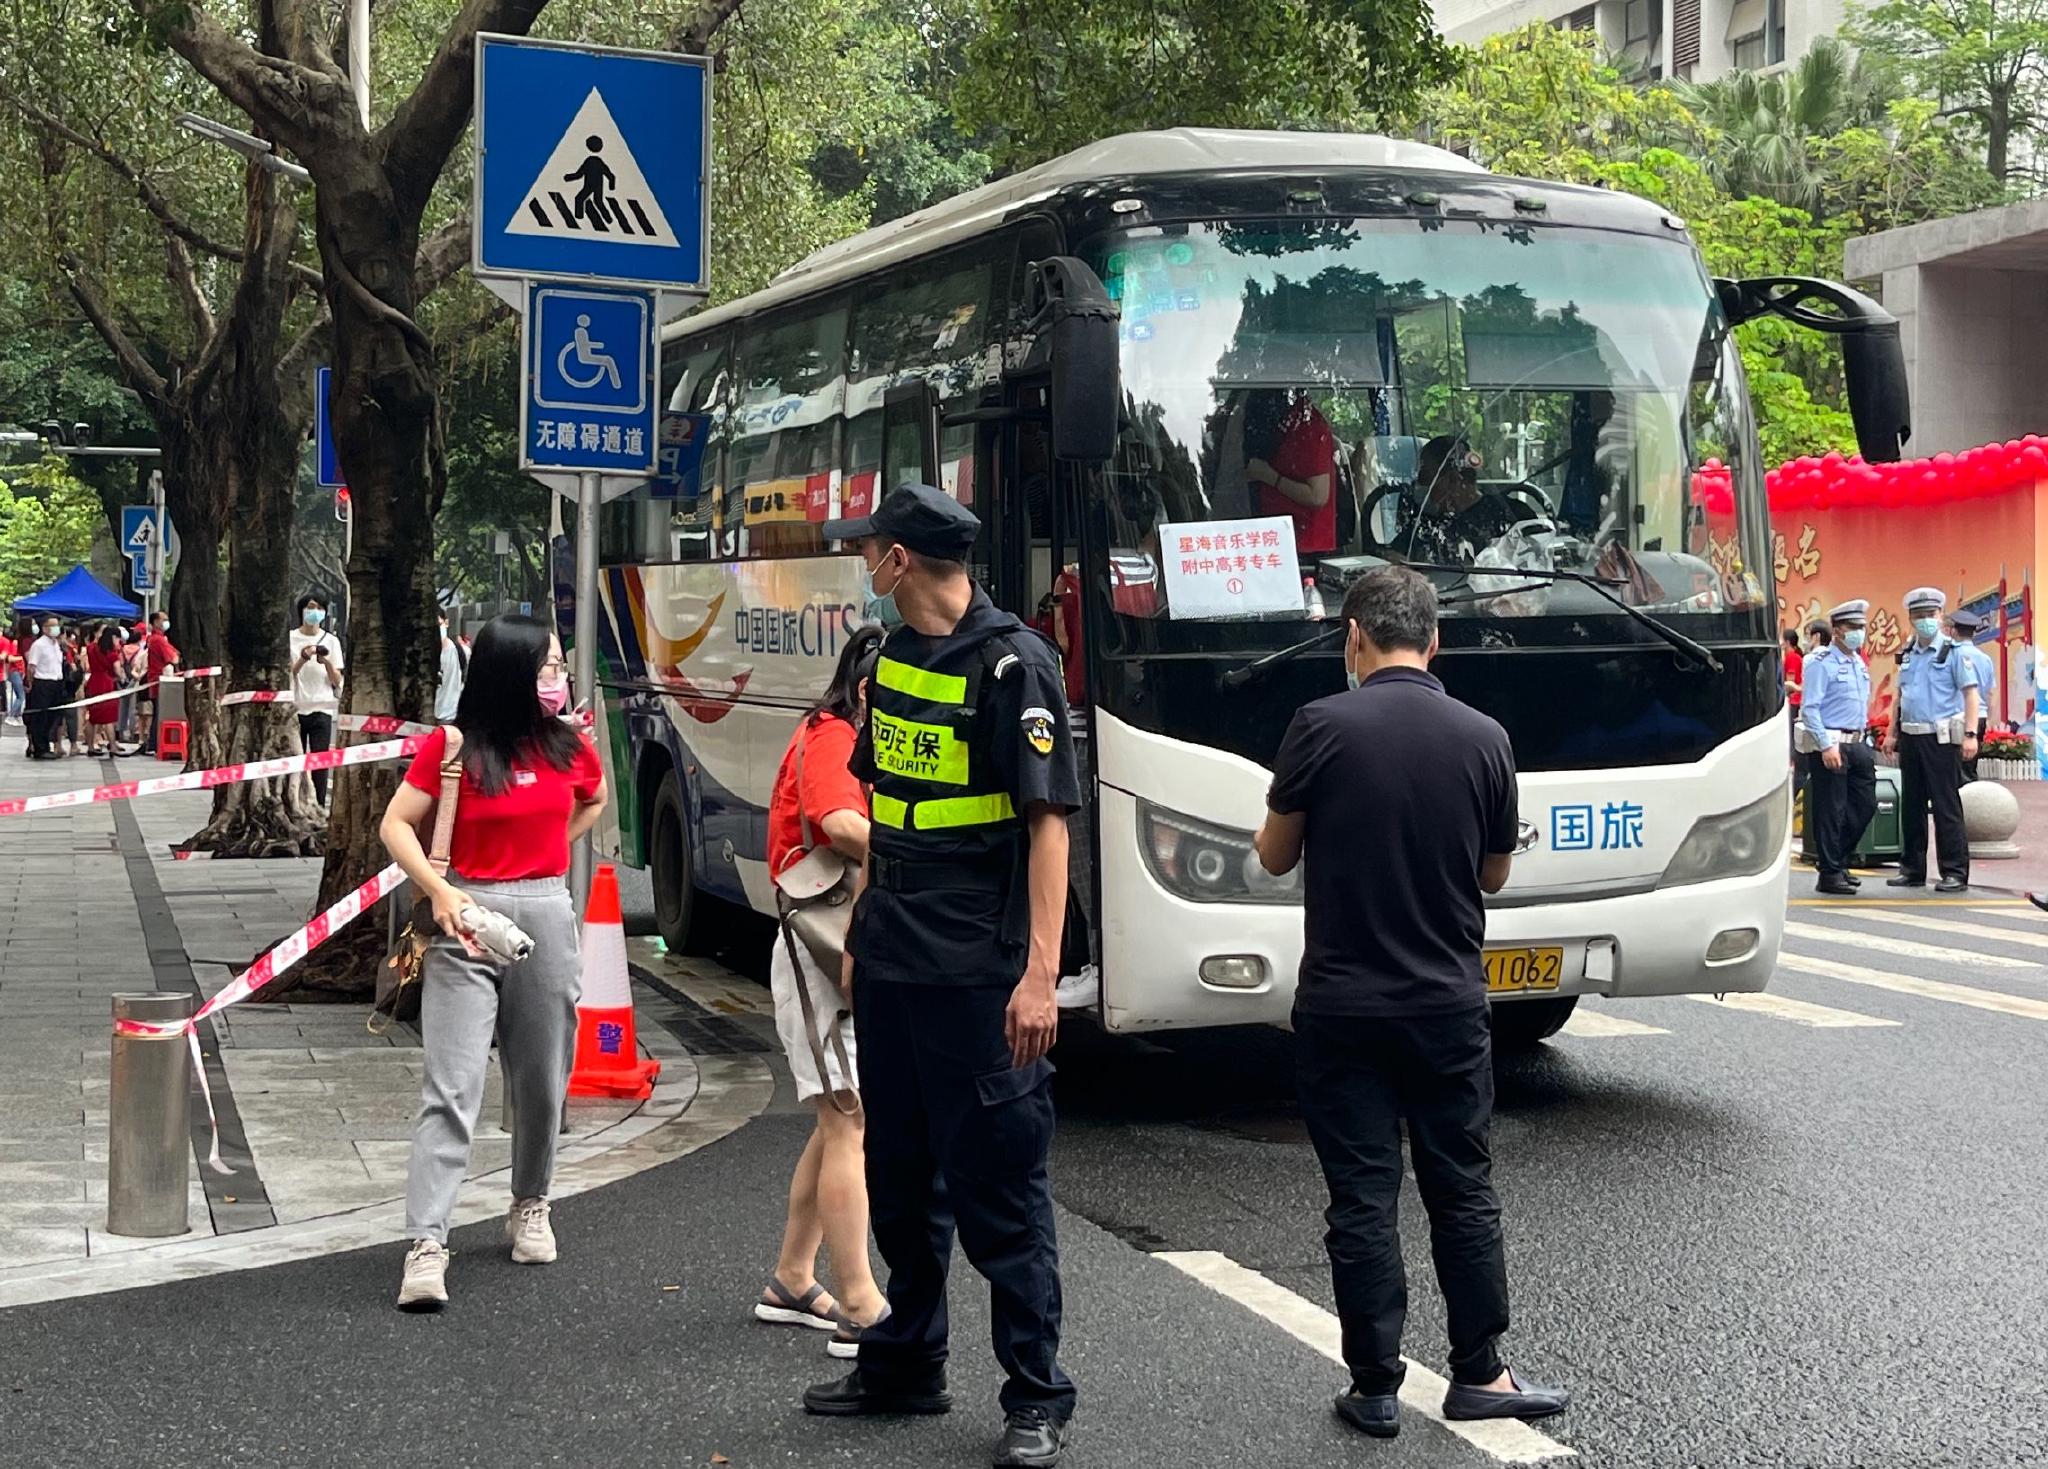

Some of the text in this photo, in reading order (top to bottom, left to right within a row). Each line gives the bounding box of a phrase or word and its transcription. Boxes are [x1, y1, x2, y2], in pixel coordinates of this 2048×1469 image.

[536, 420, 644, 456] 无障碍通道
[1179, 529, 1280, 553] 星海音乐学院
[1181, 552, 1283, 576] 附中高考专车
[736, 602, 856, 657] 中国国旅 CITS
[1551, 800, 1644, 851] 国旅
[597, 1022, 623, 1055] 警
